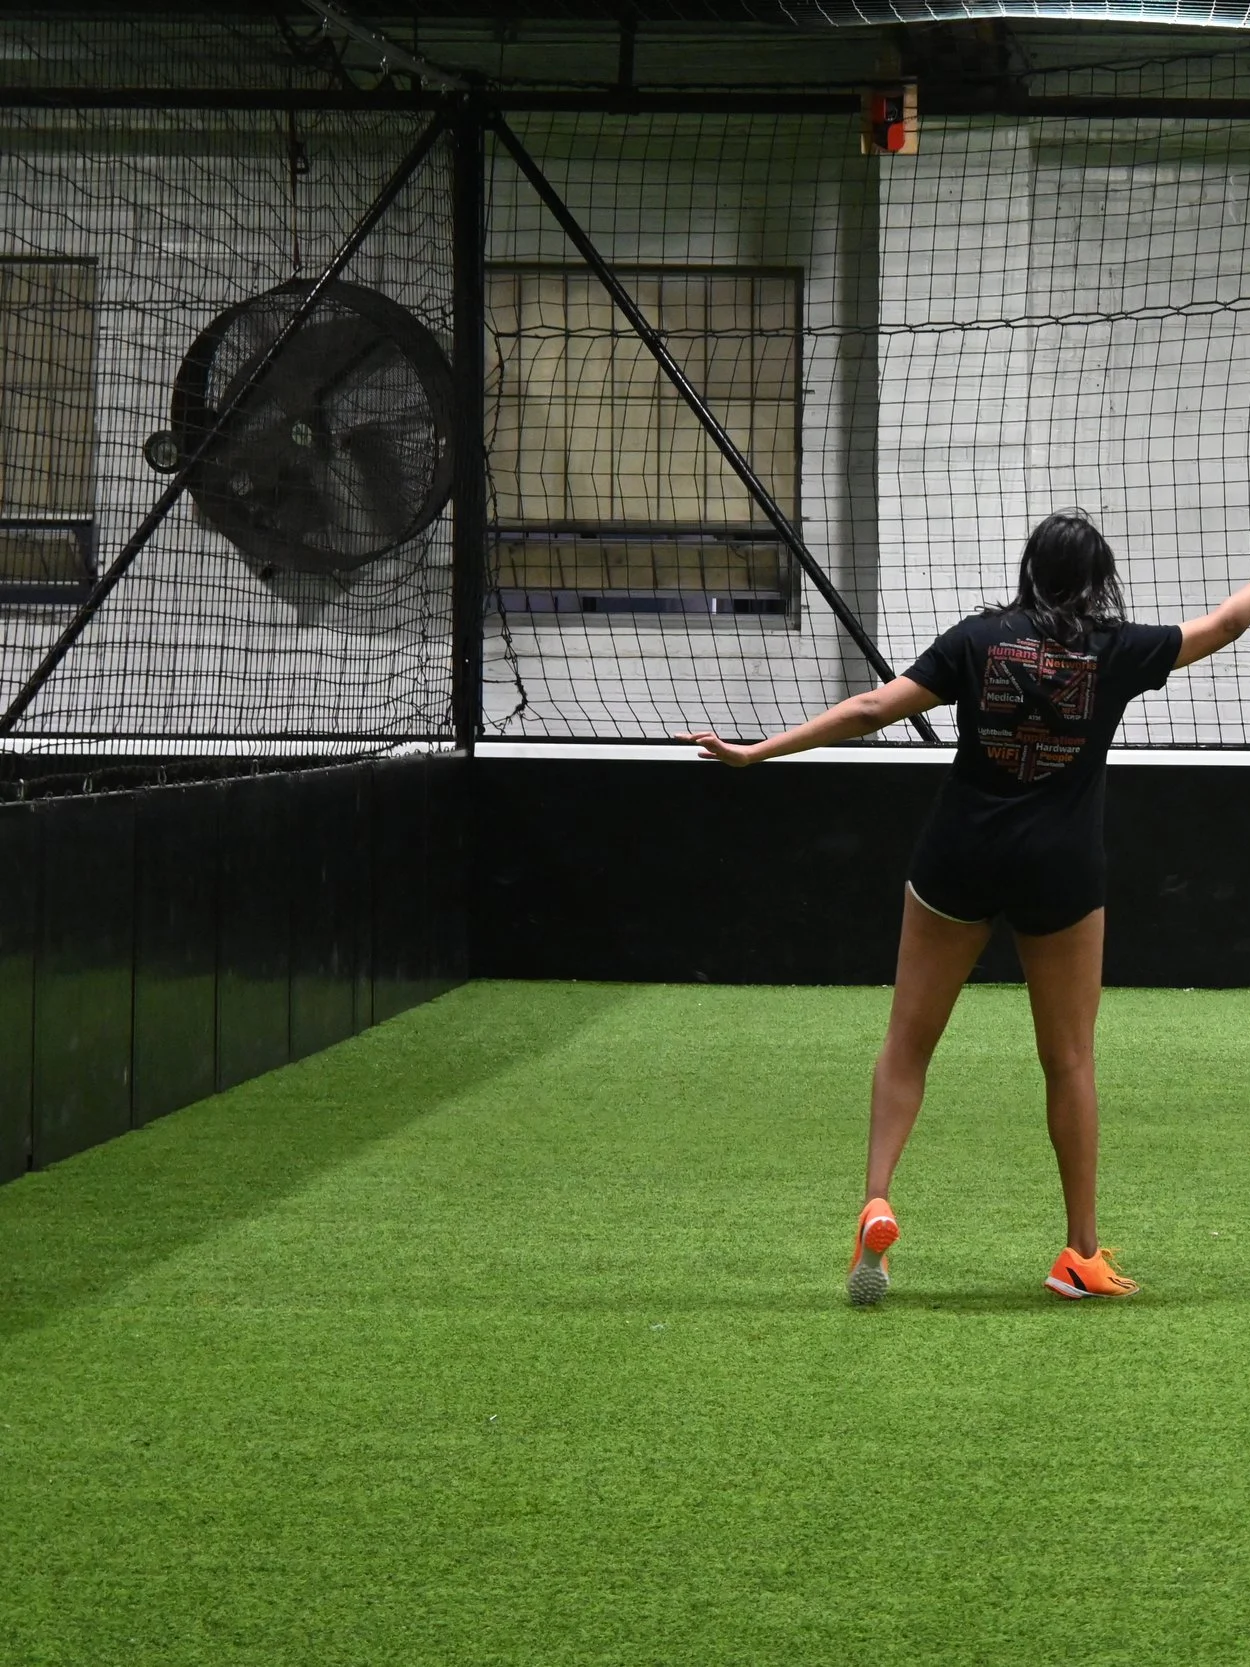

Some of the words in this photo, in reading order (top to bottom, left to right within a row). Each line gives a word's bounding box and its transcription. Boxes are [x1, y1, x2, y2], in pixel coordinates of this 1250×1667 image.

[988, 646, 1038, 660] Humans
[1045, 658, 1097, 670] Networks
[989, 677, 1009, 685] Trains
[987, 692, 1023, 703] Medical
[978, 728, 1012, 736] Lightbulbs
[1016, 731, 1086, 745] Applications
[1036, 743, 1080, 753] Hardware
[987, 747, 1019, 761] WiFi
[1040, 753, 1074, 762] People
